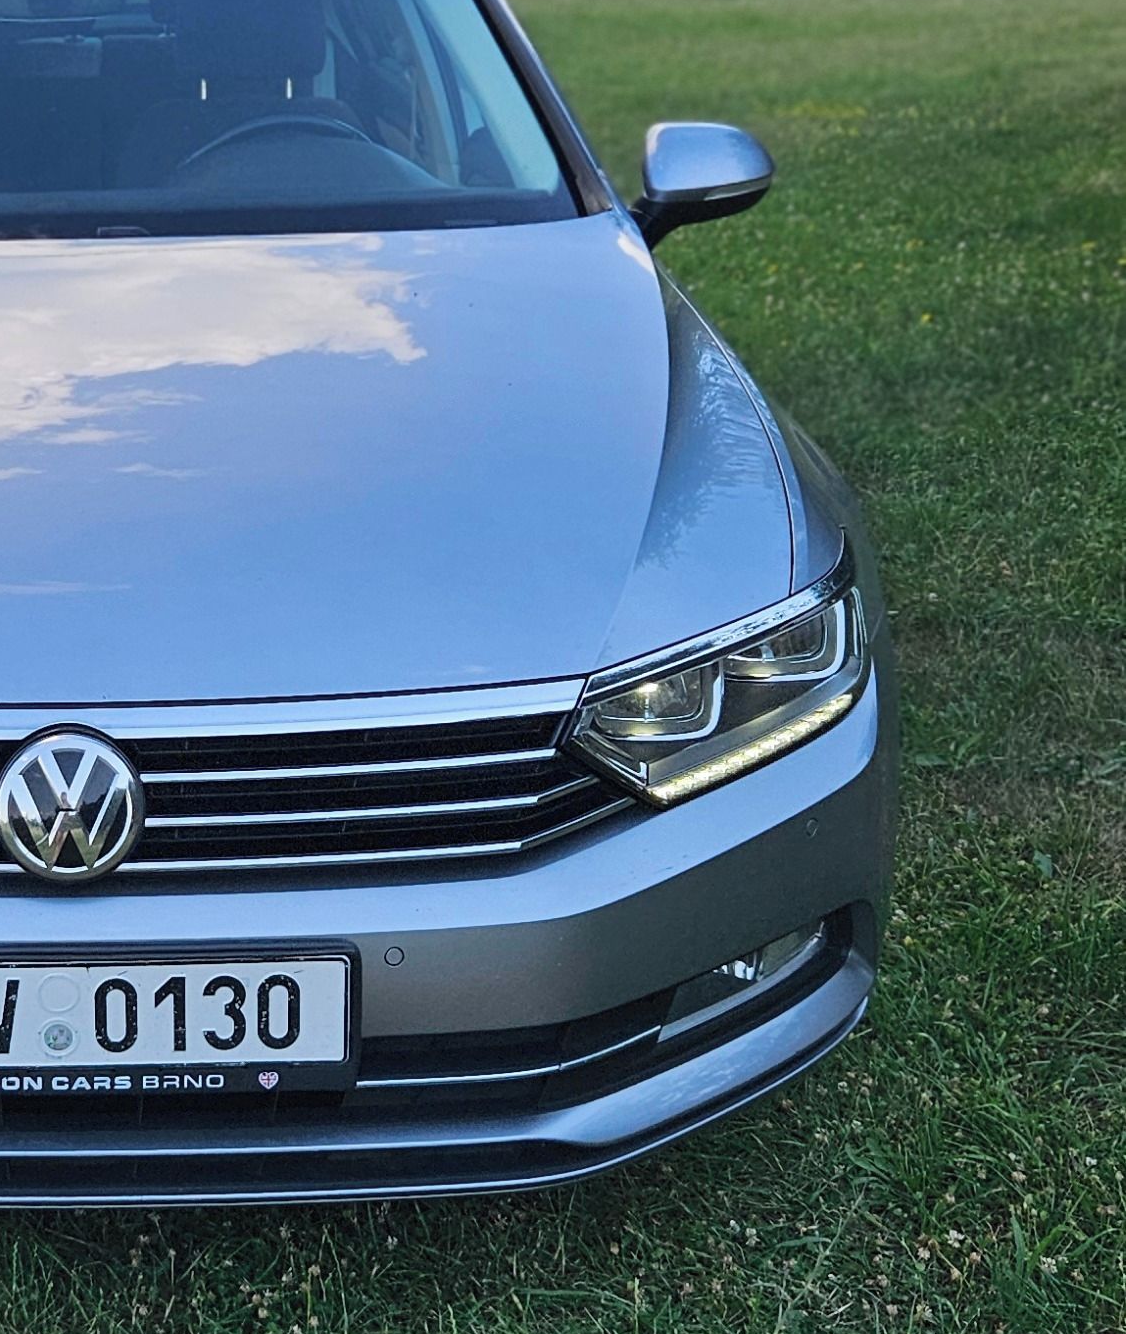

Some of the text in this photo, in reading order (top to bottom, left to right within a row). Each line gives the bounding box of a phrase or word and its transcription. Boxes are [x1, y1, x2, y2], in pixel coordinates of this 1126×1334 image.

[94, 974, 301, 1052] 0130
[51, 1076, 132, 1090] CARS
[142, 1074, 224, 1089] BRNO
